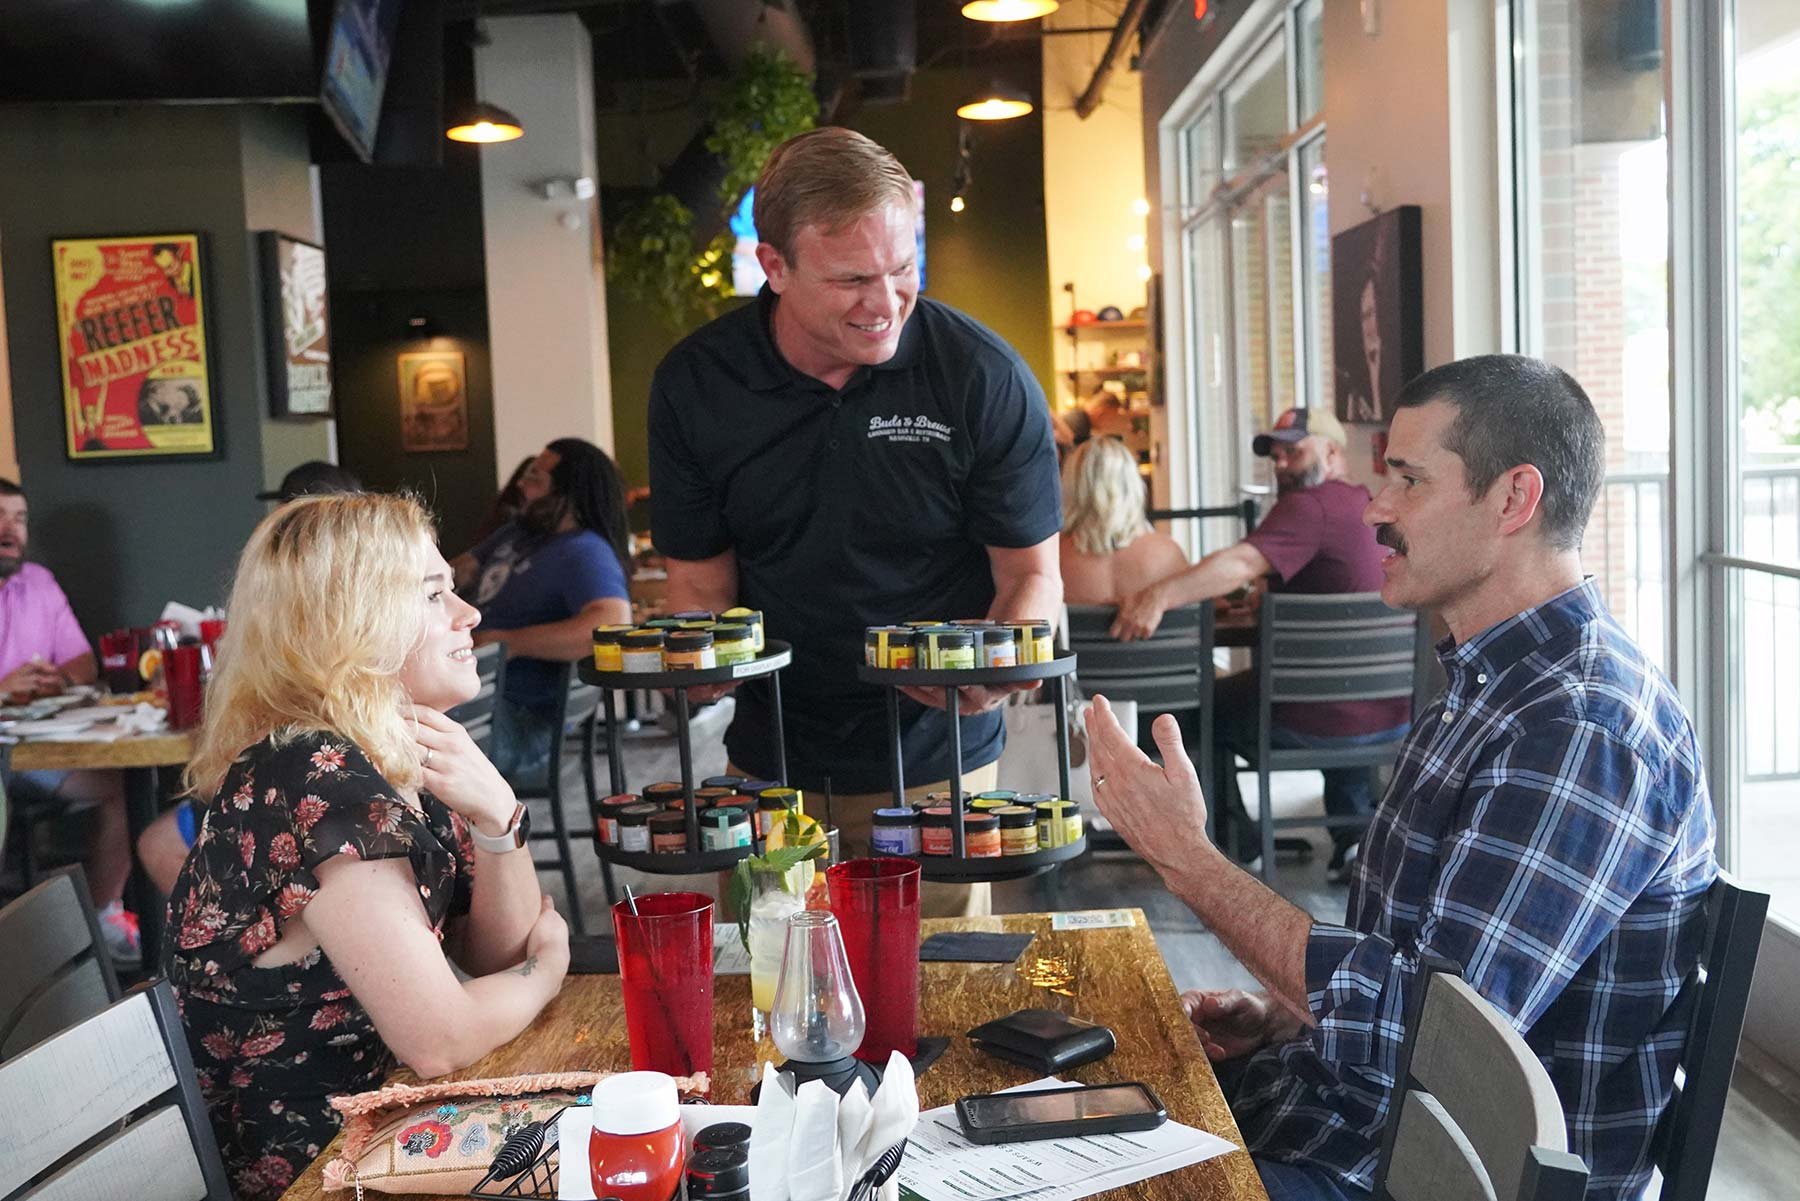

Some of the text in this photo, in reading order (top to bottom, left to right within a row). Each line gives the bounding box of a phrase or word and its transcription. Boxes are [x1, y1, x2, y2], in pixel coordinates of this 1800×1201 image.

[81, 296, 181, 353] REEFER
[81, 330, 199, 384] MADNESS
[869, 414, 951, 434] Buds & Brews
